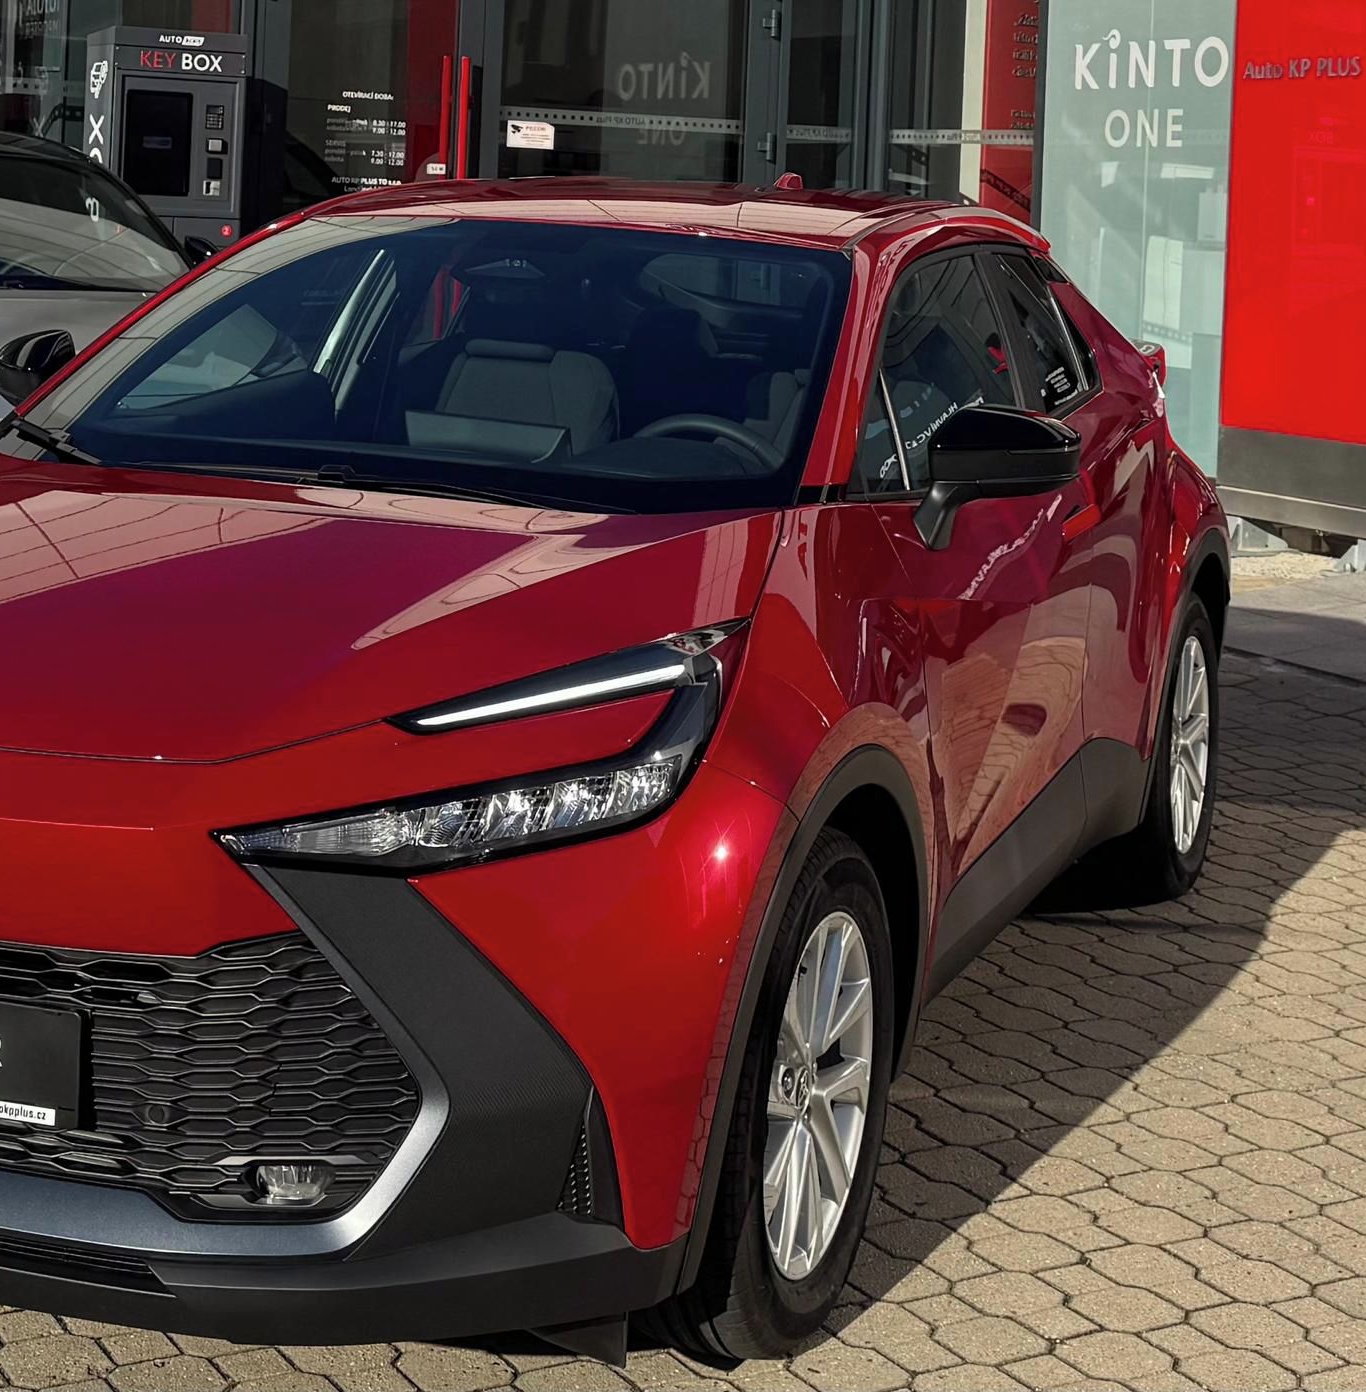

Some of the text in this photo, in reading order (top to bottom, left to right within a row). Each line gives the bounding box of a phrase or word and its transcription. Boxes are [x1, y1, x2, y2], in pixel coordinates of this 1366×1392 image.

[159, 35, 183, 44] AUTO
[140, 50, 223, 73] KEY BOX
[1243, 56, 1362, 79] Auto KP PLUS
[1105, 109, 1184, 148] ONE
